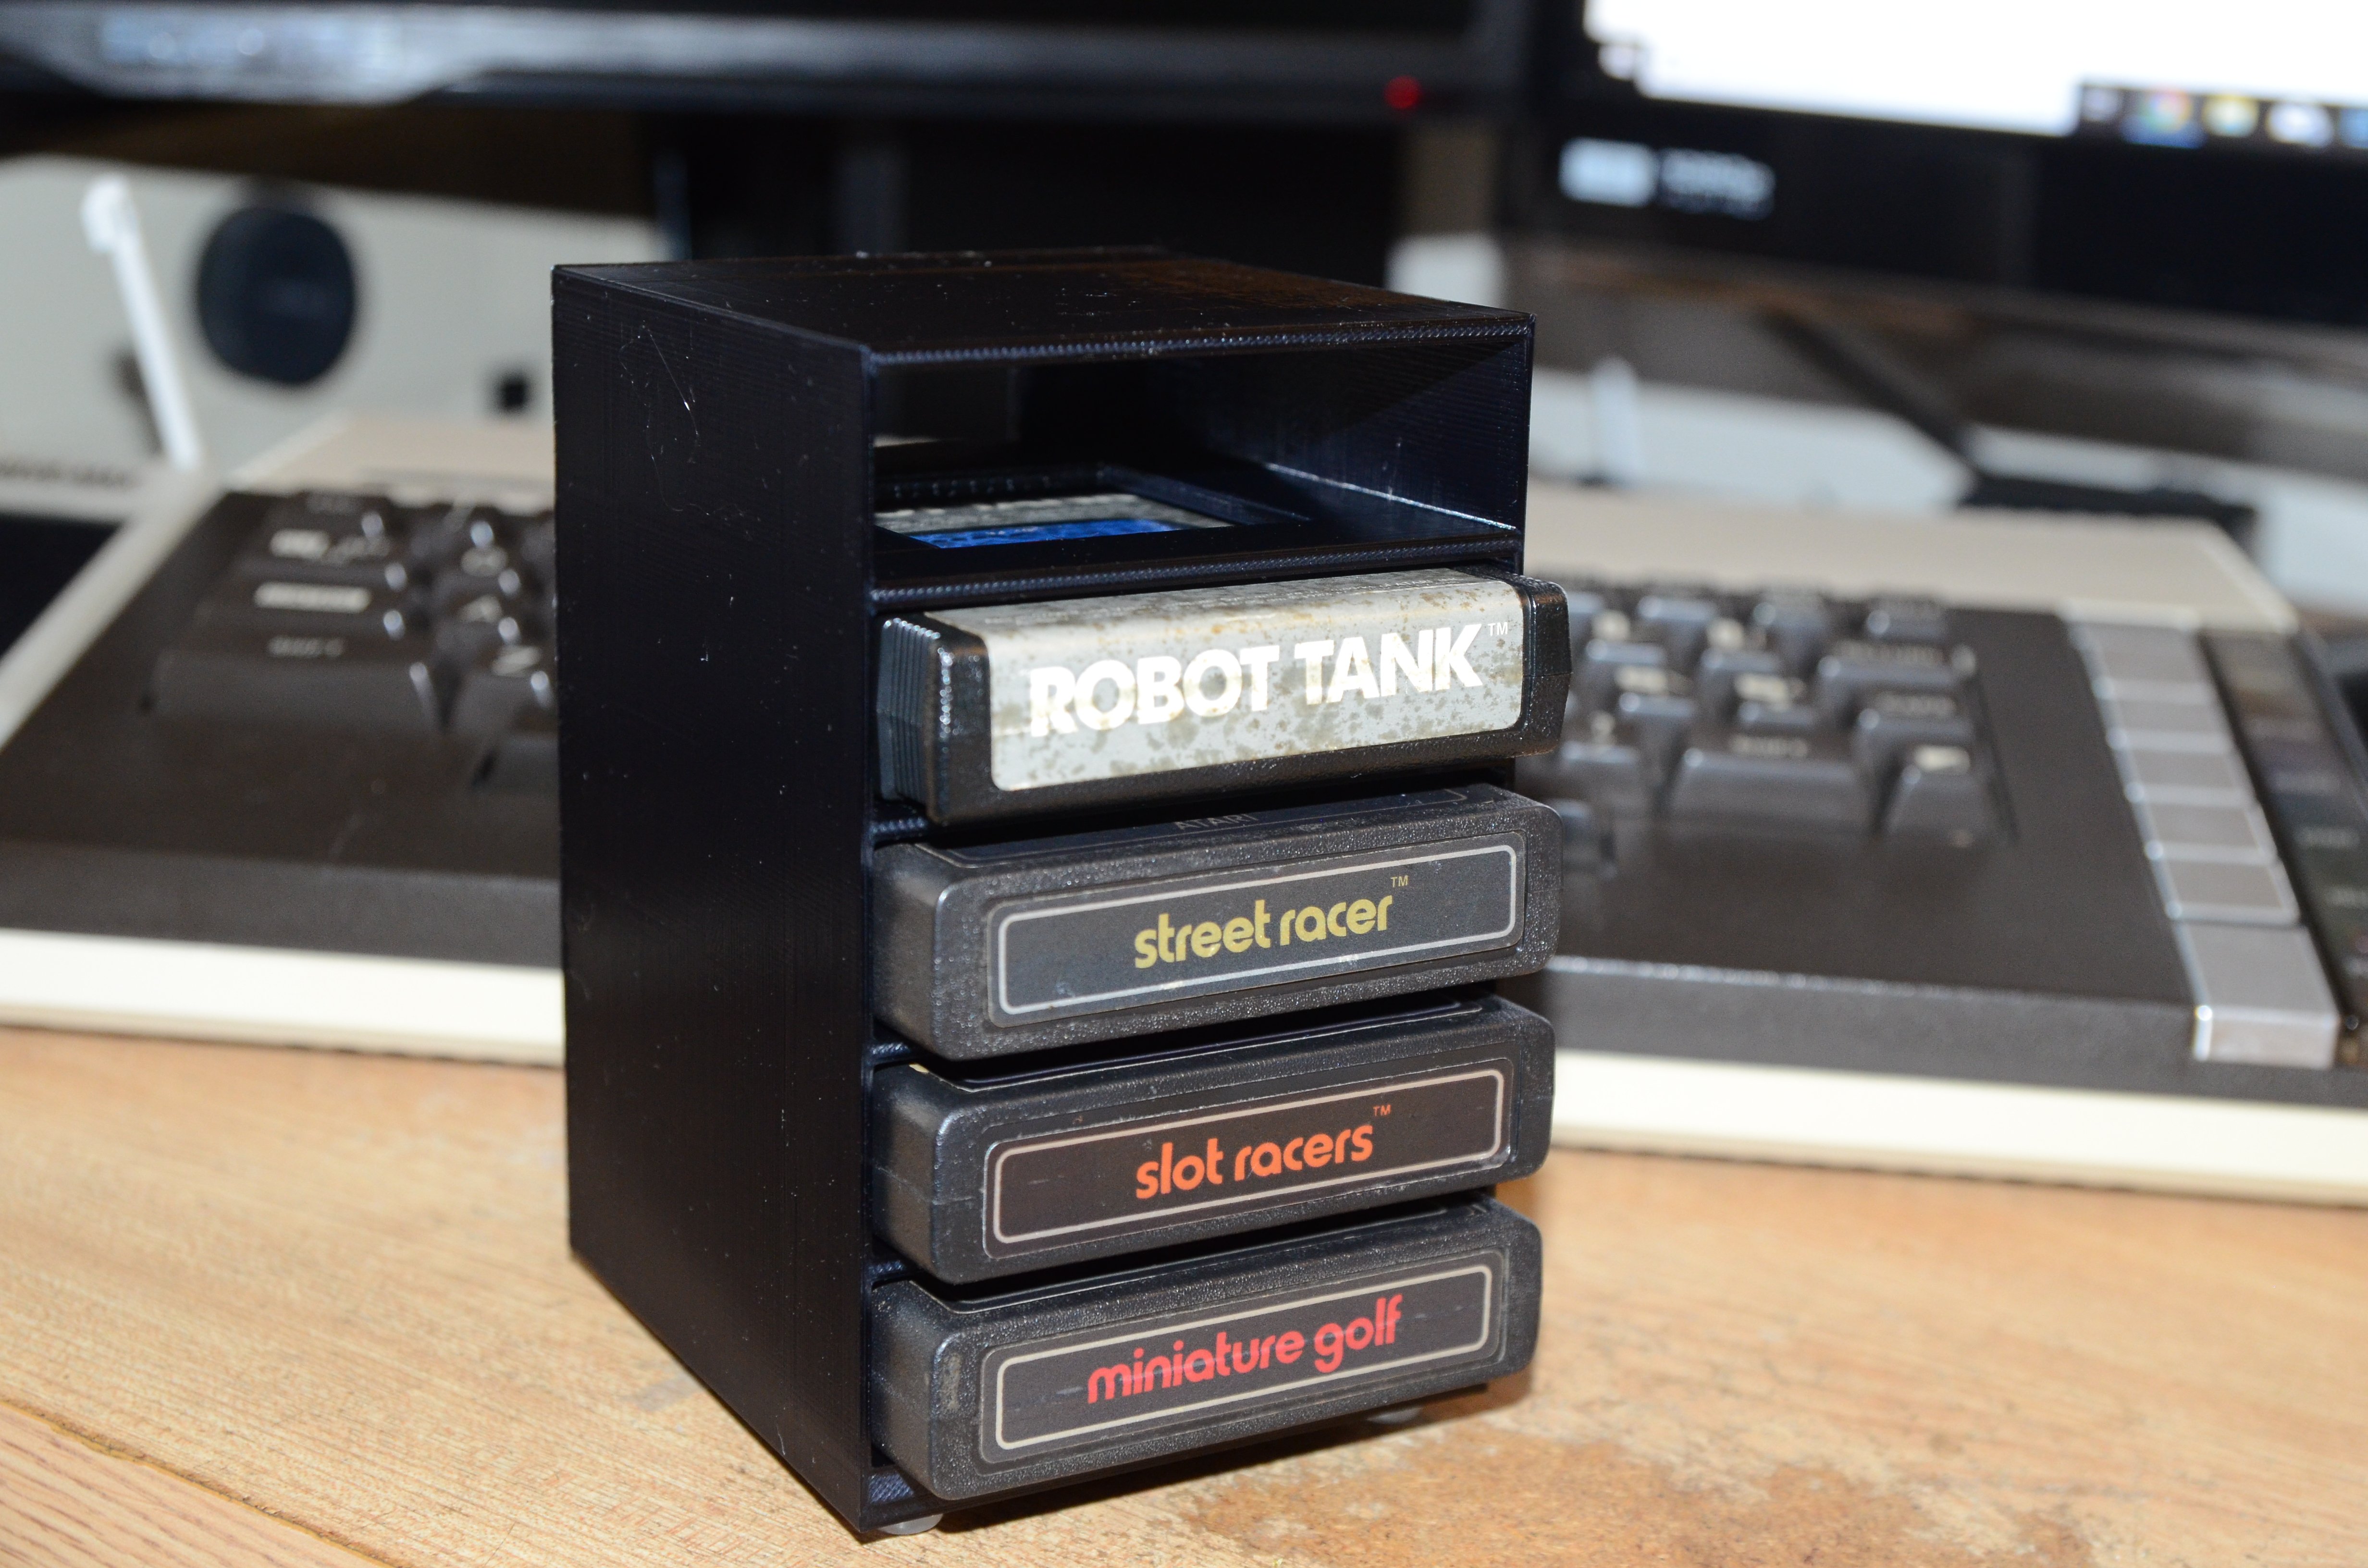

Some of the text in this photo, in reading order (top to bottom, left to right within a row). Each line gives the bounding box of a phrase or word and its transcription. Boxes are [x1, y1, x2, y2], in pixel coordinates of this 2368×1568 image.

[1029, 622, 1508, 737] ROBOT TANK TM
[1175, 813, 1258, 830] ATARI
[1135, 875, 1408, 968] street racer TM
[1135, 1103, 1392, 1200] slot racers TM
[1087, 1293, 1403, 1404] miniature golf
